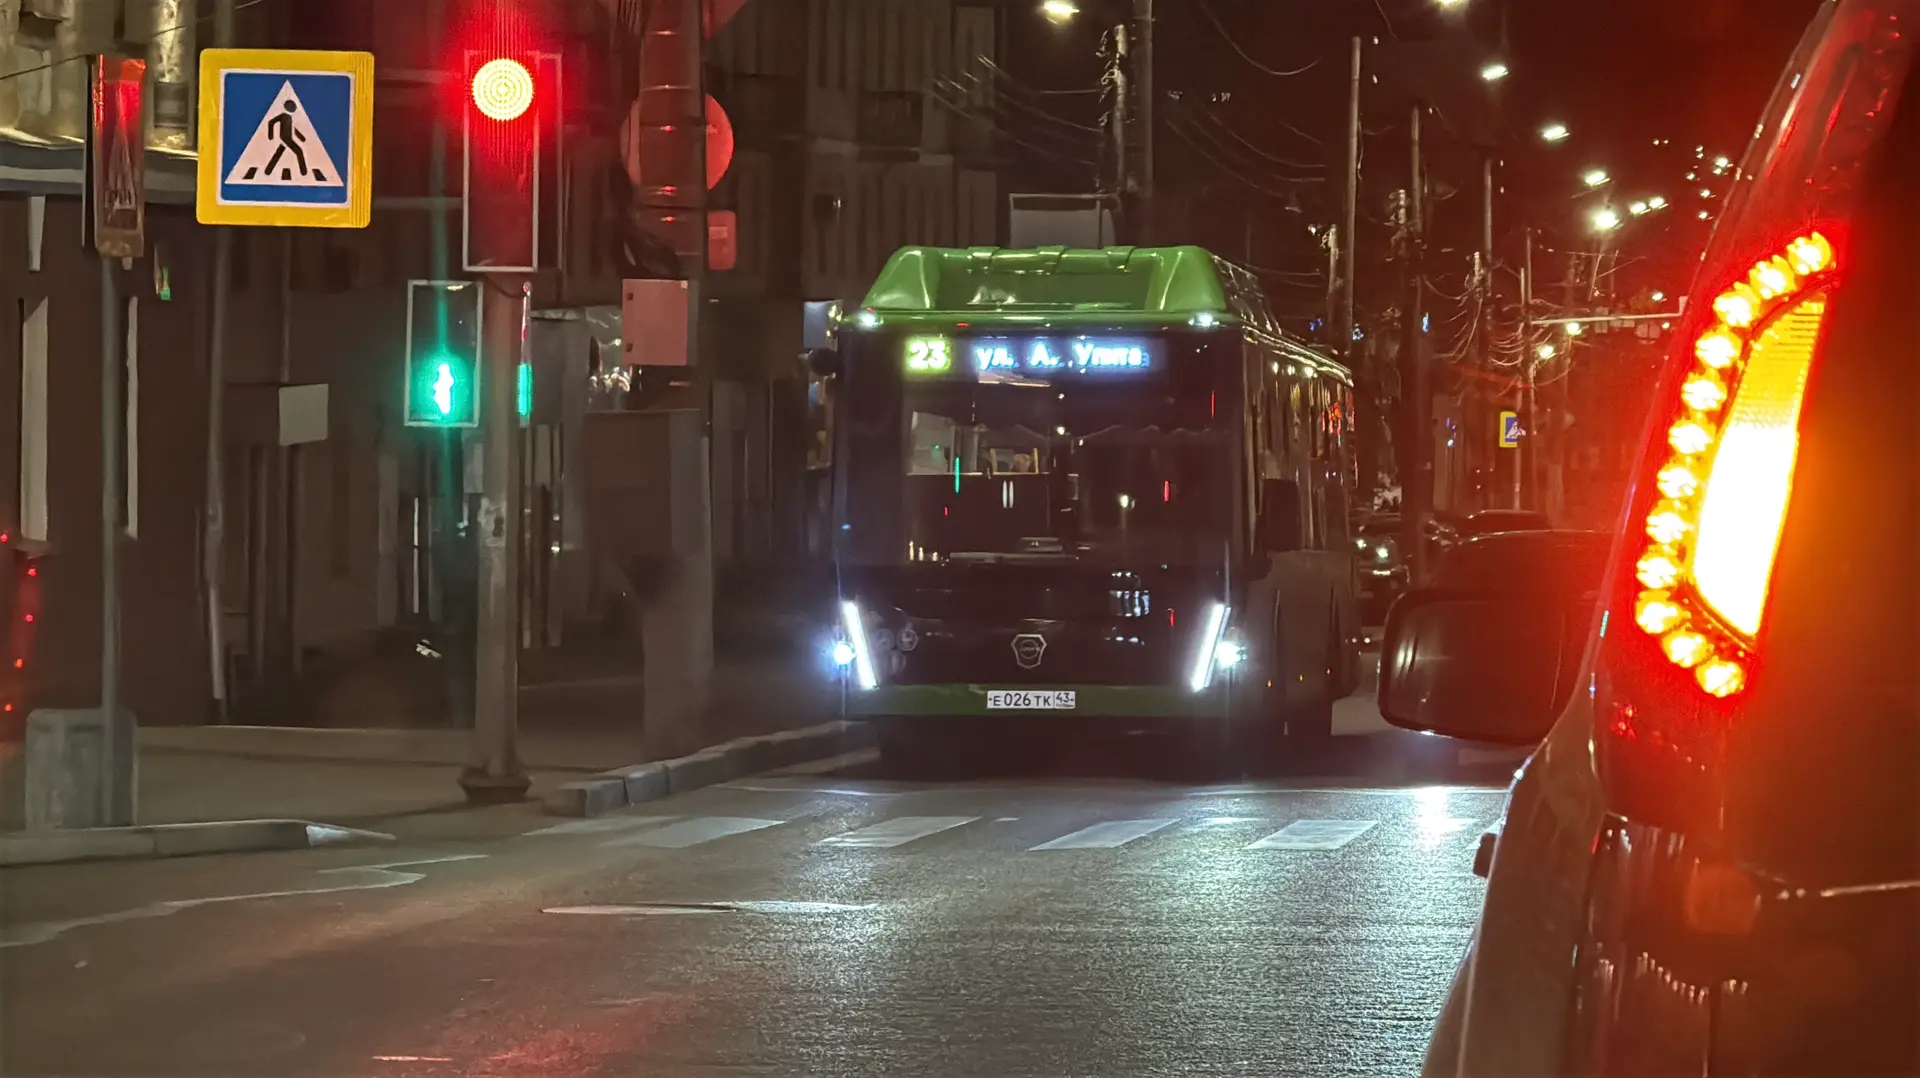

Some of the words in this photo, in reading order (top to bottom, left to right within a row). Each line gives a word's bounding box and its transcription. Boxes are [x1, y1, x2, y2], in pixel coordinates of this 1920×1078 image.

[908, 340, 947, 369] 23
[976, 348, 1014, 371] ул.
[1031, 343, 1058, 366] А.
[1055, 692, 1070, 703] 43
